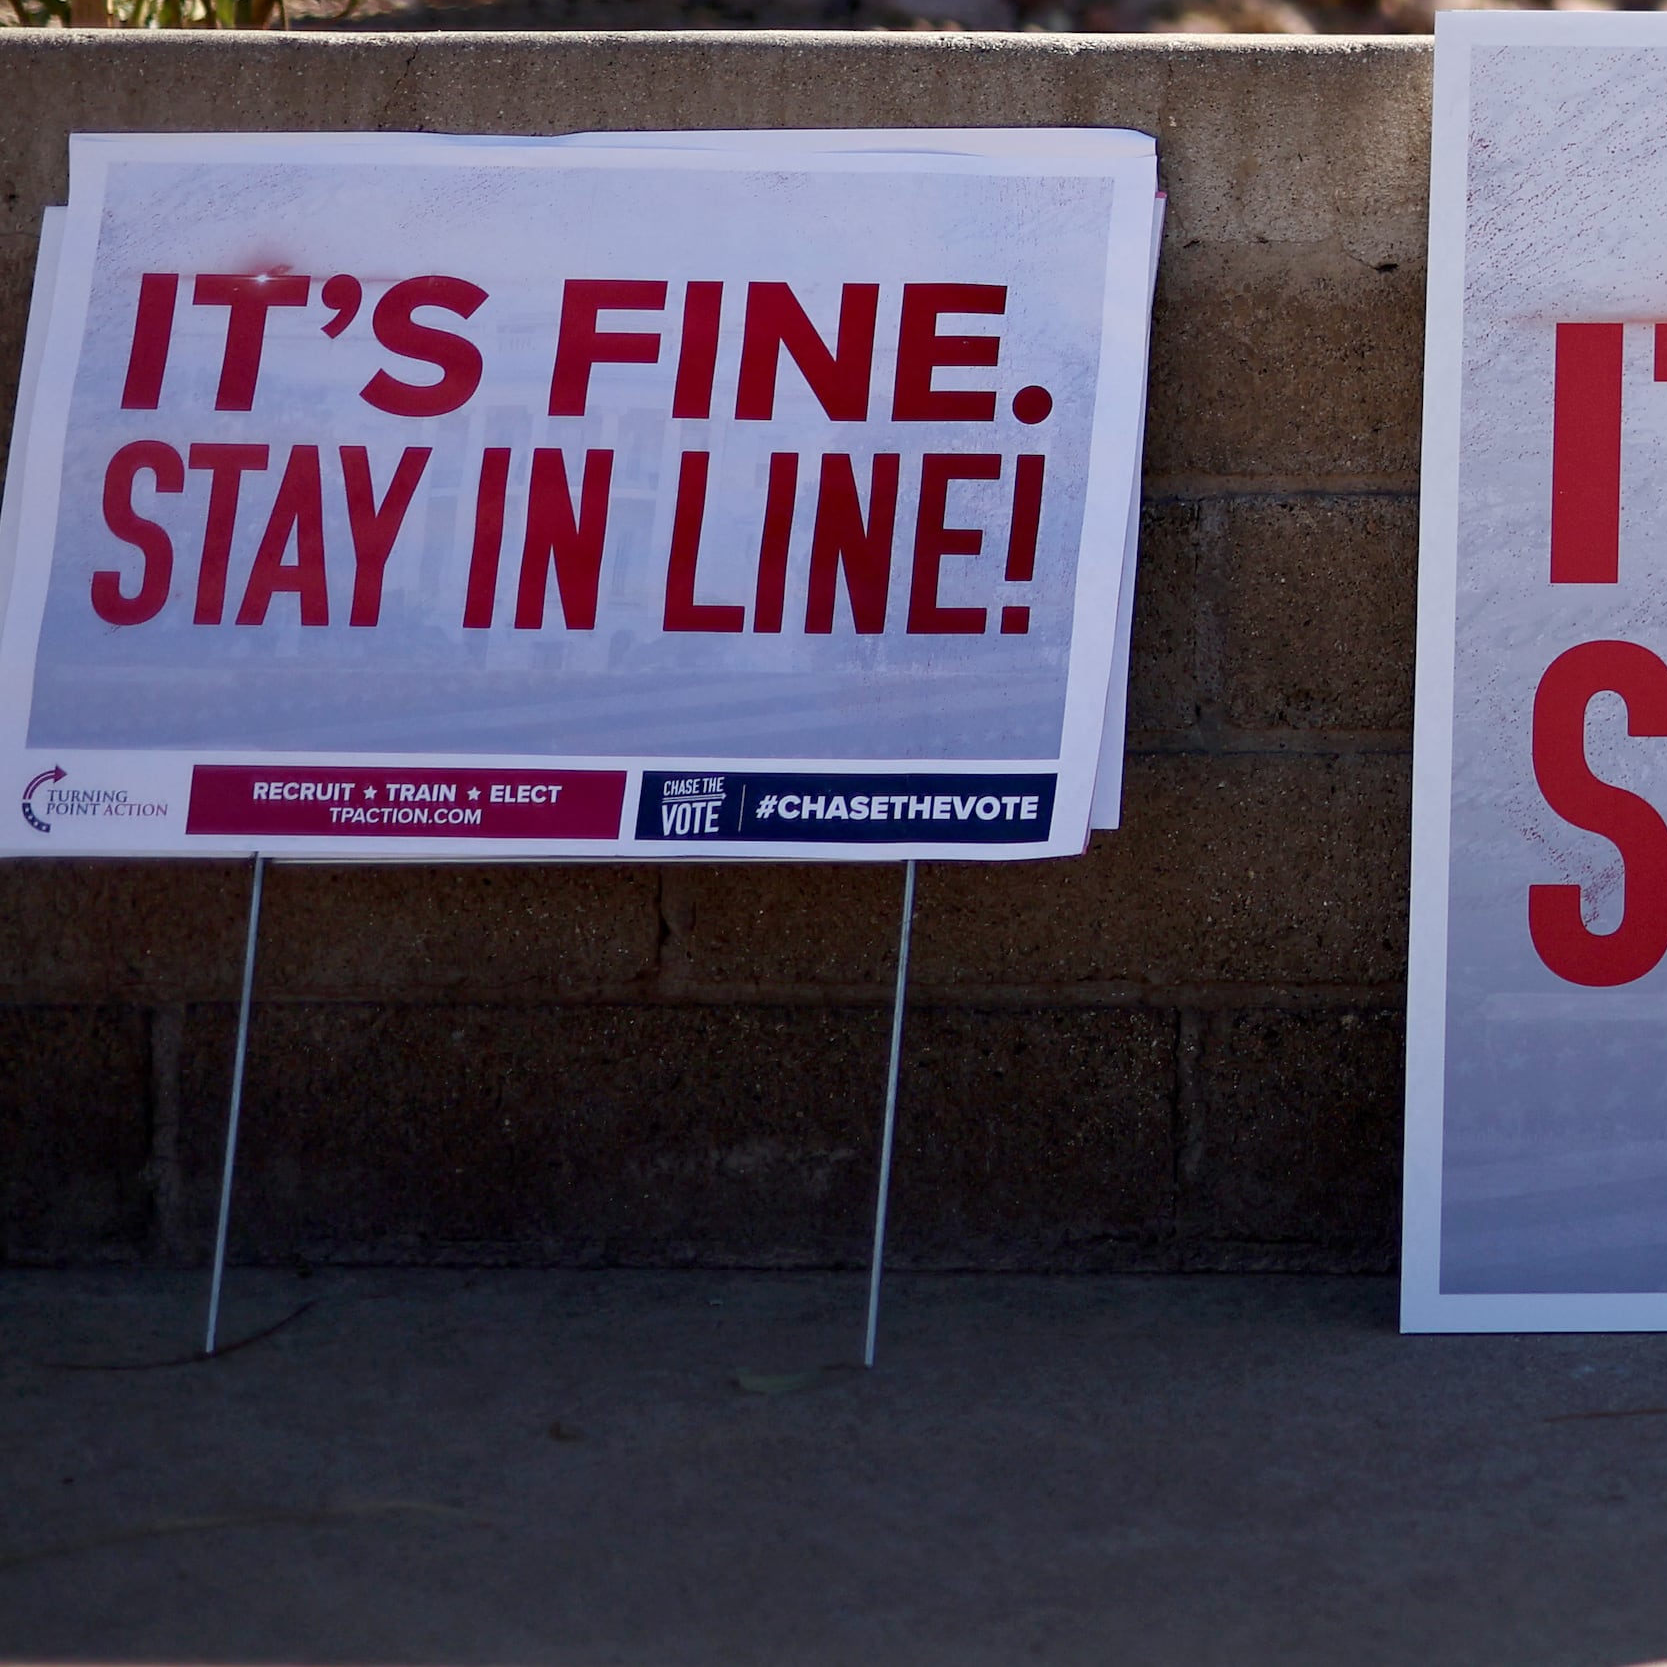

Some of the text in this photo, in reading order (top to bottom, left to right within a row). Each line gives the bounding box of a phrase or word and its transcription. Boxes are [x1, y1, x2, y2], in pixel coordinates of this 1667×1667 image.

[124, 273, 1052, 424] IT’S FINE.
[91, 440, 1045, 634] STAY IN LINE!
[46, 788, 129, 804] TURNING
[253, 781, 562, 804] RECRUIT TRAIN ELECT
[663, 776, 725, 796] CHASE THE
[45, 801, 168, 818] POINT ACTION
[329, 807, 482, 825] TPACTION.COM
[661, 800, 721, 836] VOTE
[755, 794, 1039, 821] #CHASETHEVOTE
